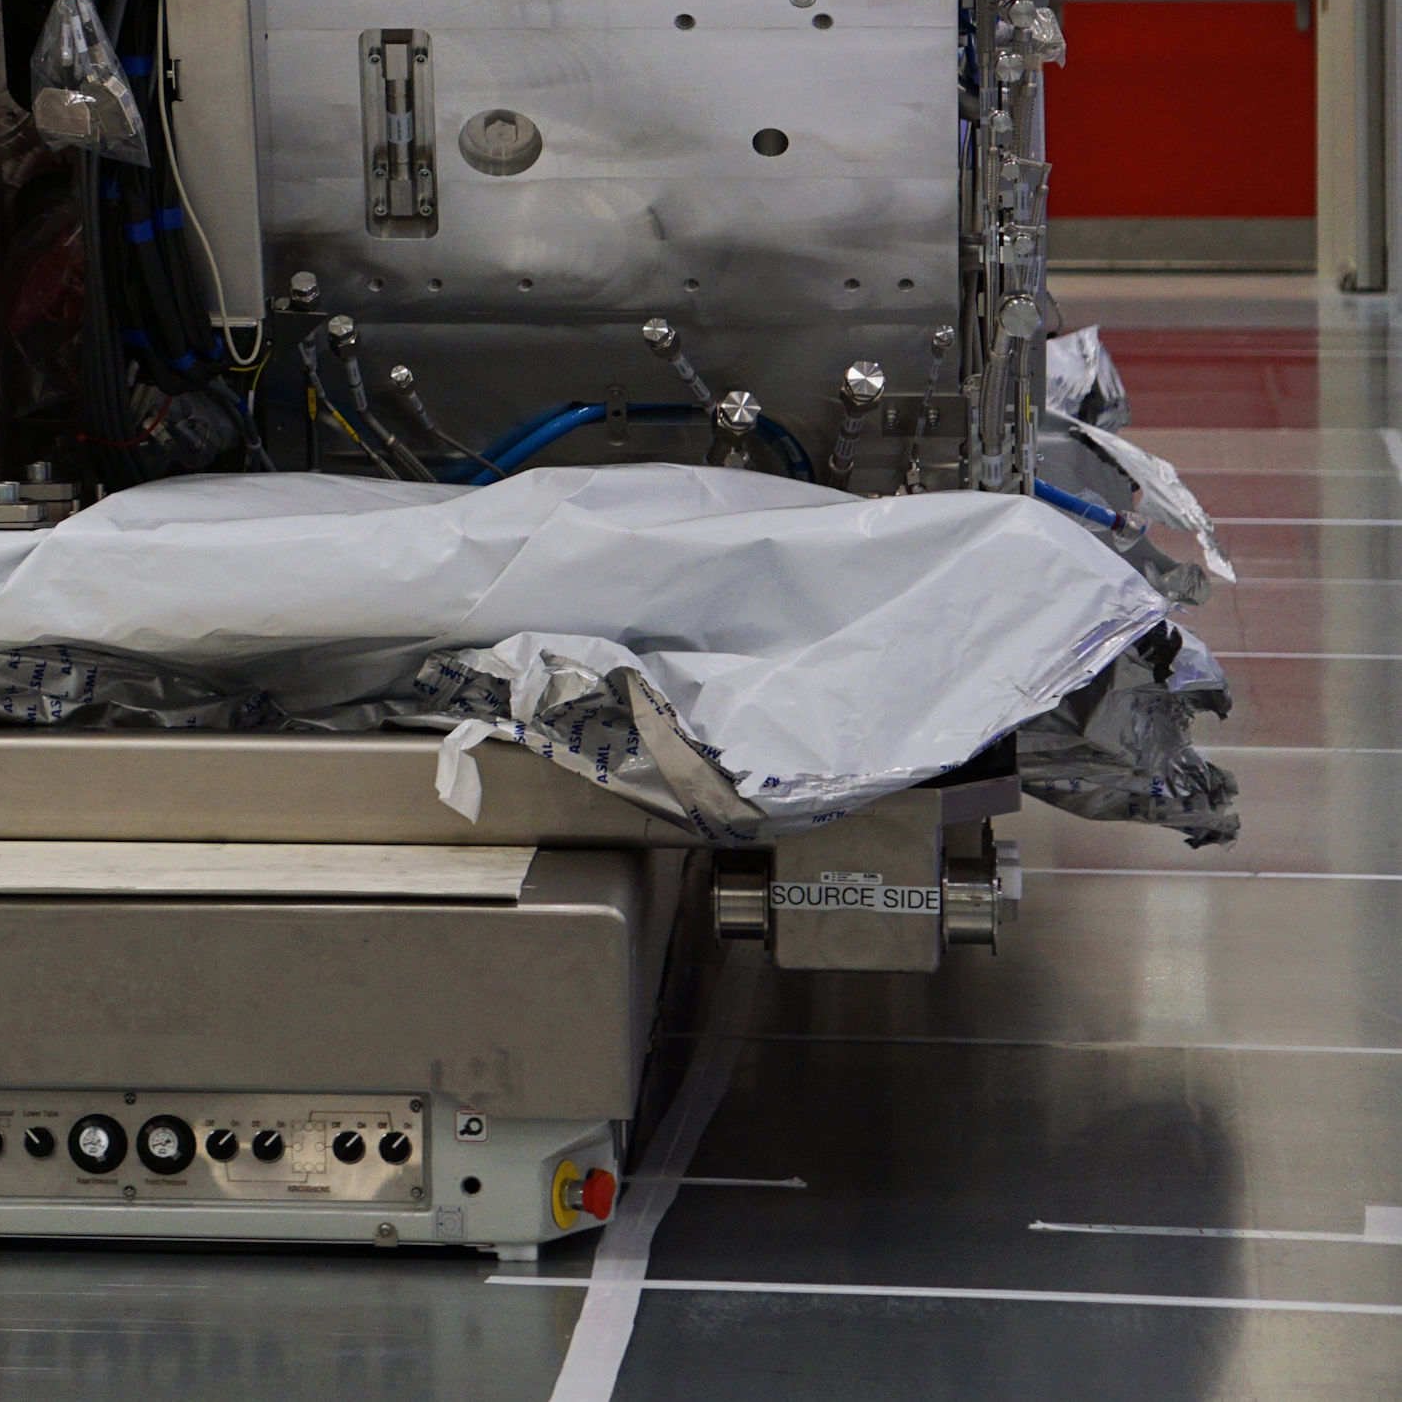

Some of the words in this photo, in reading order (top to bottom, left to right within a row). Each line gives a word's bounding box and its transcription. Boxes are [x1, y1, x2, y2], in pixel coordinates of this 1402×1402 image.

[30, 662, 47, 690] SML
[569, 717, 587, 754] ASML
[596, 743, 611, 784] ASML
[812, 810, 846, 824] ASML
[771, 884, 876, 907] SOURCE
[883, 888, 939, 910] SIDE
